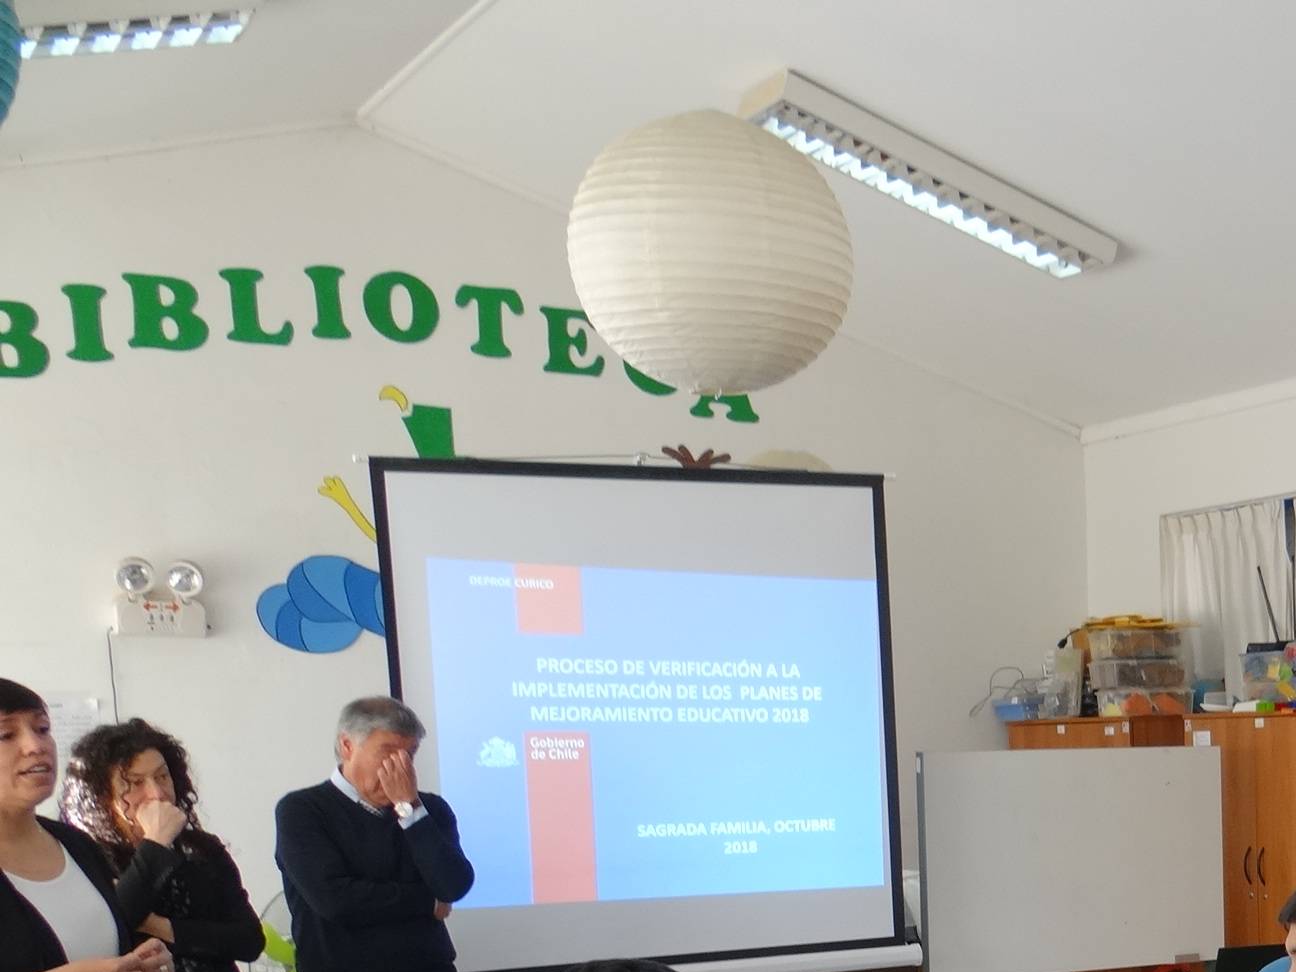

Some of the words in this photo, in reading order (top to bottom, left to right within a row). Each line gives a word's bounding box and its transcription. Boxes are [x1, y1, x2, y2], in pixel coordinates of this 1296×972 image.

[0, 265, 760, 423] BIBLIOTE
[536, 658, 618, 675] PROCESO
[622, 659, 646, 676] DE
[649, 658, 762, 679] VERIFICACIÓN
[766, 663, 778, 678] A
[781, 663, 801, 679] LA
[512, 680, 672, 700] IMPLEMENTACIÓN
[676, 684, 698, 700] DE
[702, 684, 732, 700] LOS
[740, 685, 798, 701] PLANES
[802, 686, 823, 701] DE
[530, 706, 673, 722] MEJORAMIENTO
[677, 707, 769, 723] EDUCATIVO
[772, 707, 810, 723] 2018
[530, 736, 585, 749] Gobierno
[530, 748, 546, 760] de
[548, 747, 580, 760] Chile
[637, 822, 707, 838] SAGRADA
[710, 820, 771, 836] FAMILIA,
[774, 818, 836, 833] OCTUBRE
[723, 840, 759, 855] 2018
